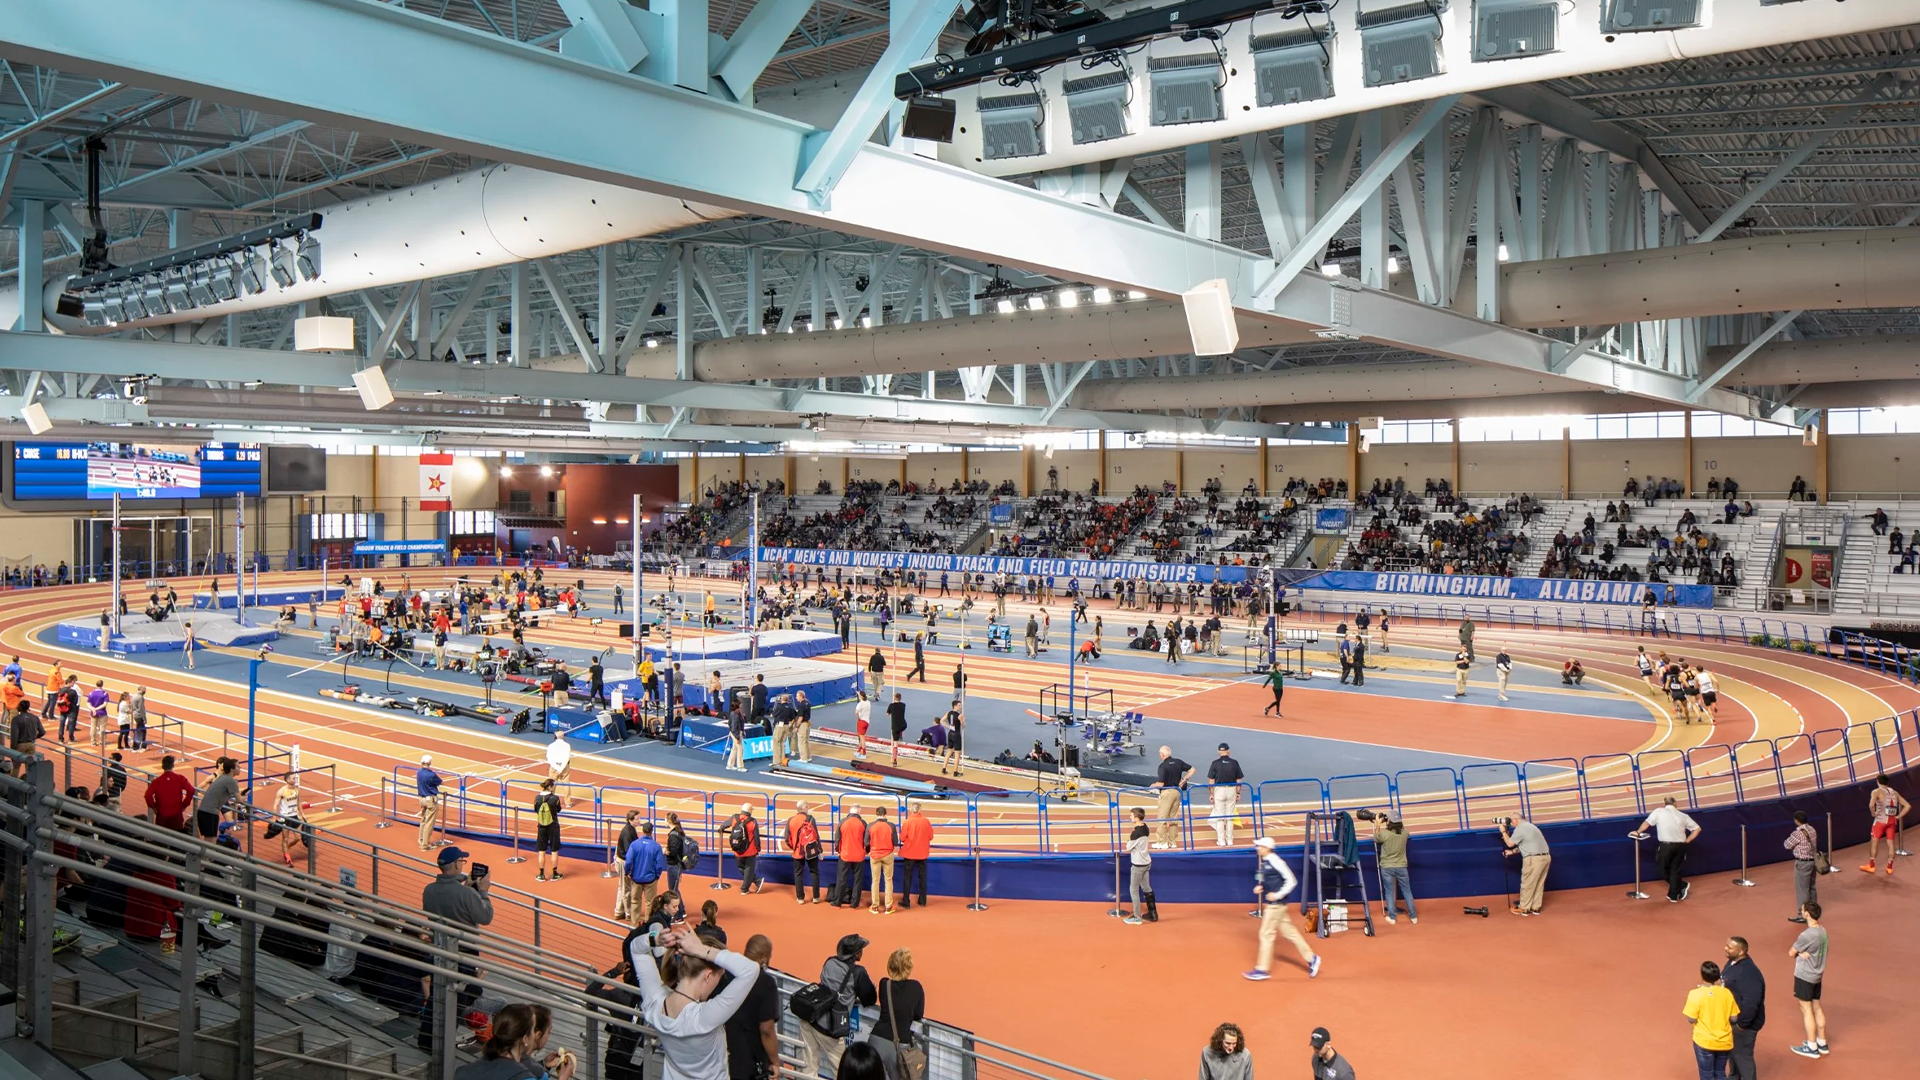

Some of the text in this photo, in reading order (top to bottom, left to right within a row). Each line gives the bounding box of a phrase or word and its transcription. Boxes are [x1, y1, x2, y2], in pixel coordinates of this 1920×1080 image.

[1114, 466, 1122, 474] 13
[1274, 464, 1283, 472] 12
[1704, 460, 1718, 470] 10
[794, 550, 826, 563] MEN'S
[829, 551, 849, 565] AND
[853, 552, 904, 568] WOMEN'S
[908, 554, 950, 570] INDOOR
[956, 556, 994, 572] TRACK
[998, 558, 1023, 574] AND
[1030, 560, 1065, 575] FIELD
[1070, 561, 1196, 581] CHAMPIONSHIPS
[1376, 574, 1646, 603] BIRMINGHAM, ALABAMA
